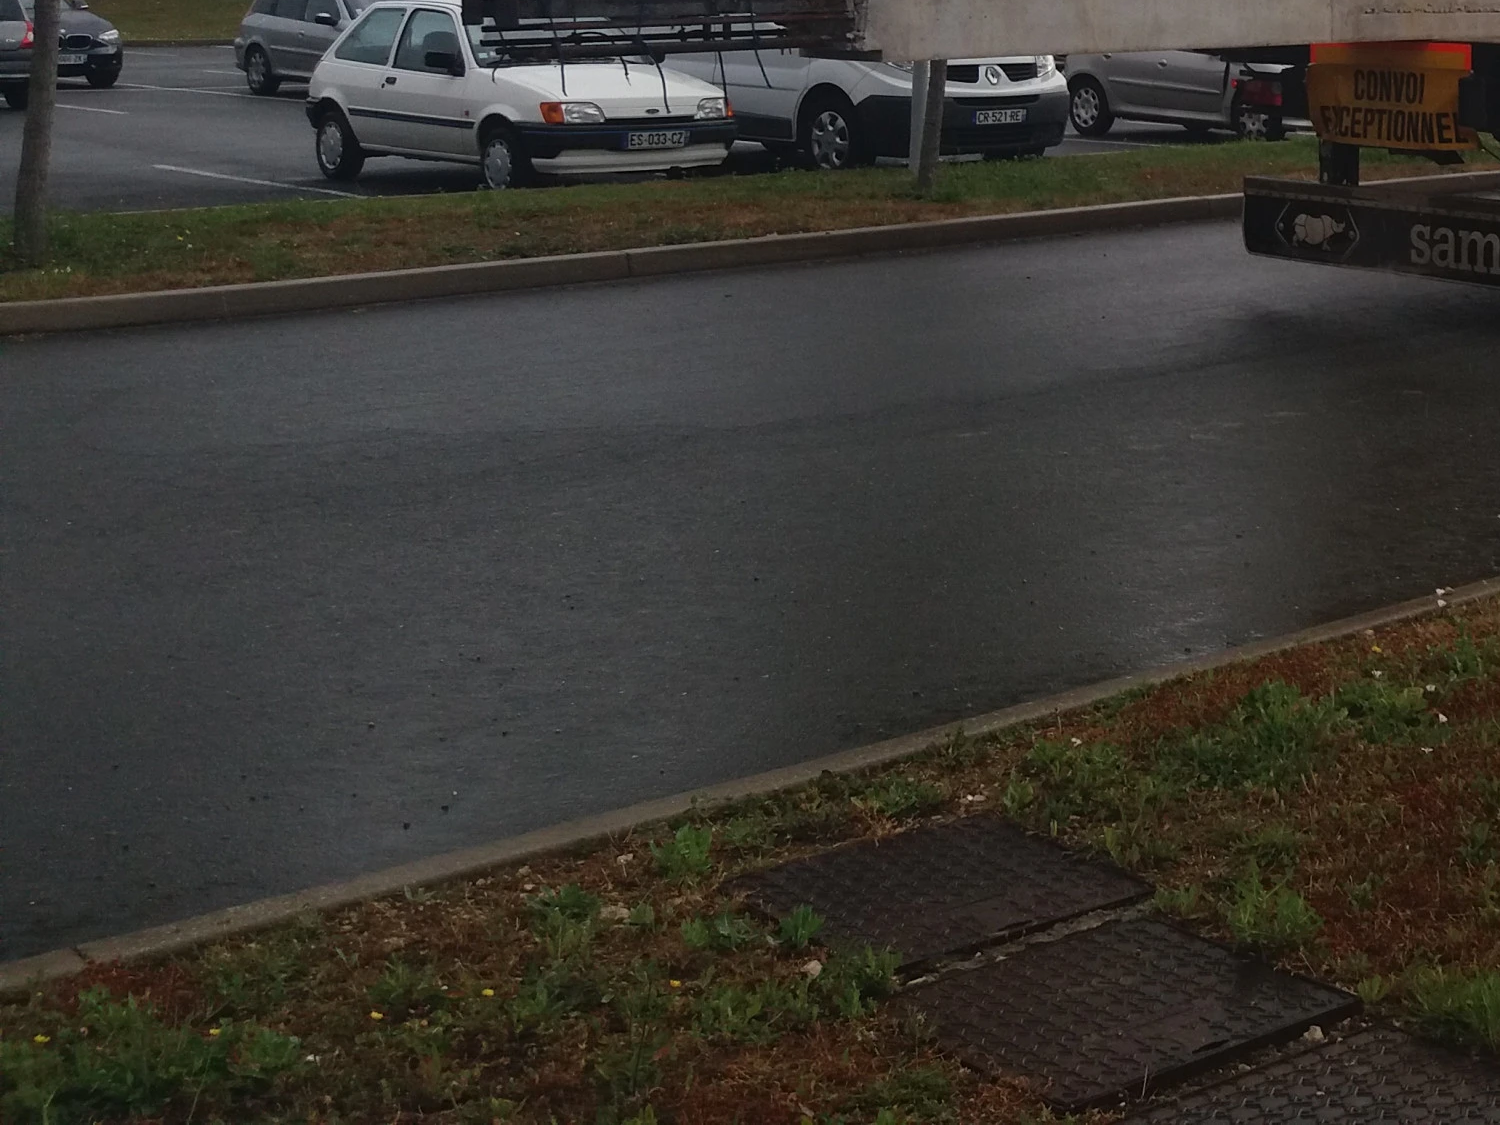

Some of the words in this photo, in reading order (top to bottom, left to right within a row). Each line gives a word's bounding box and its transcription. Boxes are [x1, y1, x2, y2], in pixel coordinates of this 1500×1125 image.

[1353, 69, 1425, 104] CONVOI
[629, 131, 684, 147] ES-033-CZ
[1320, 105, 1469, 144] EXCEPTIONNEL
